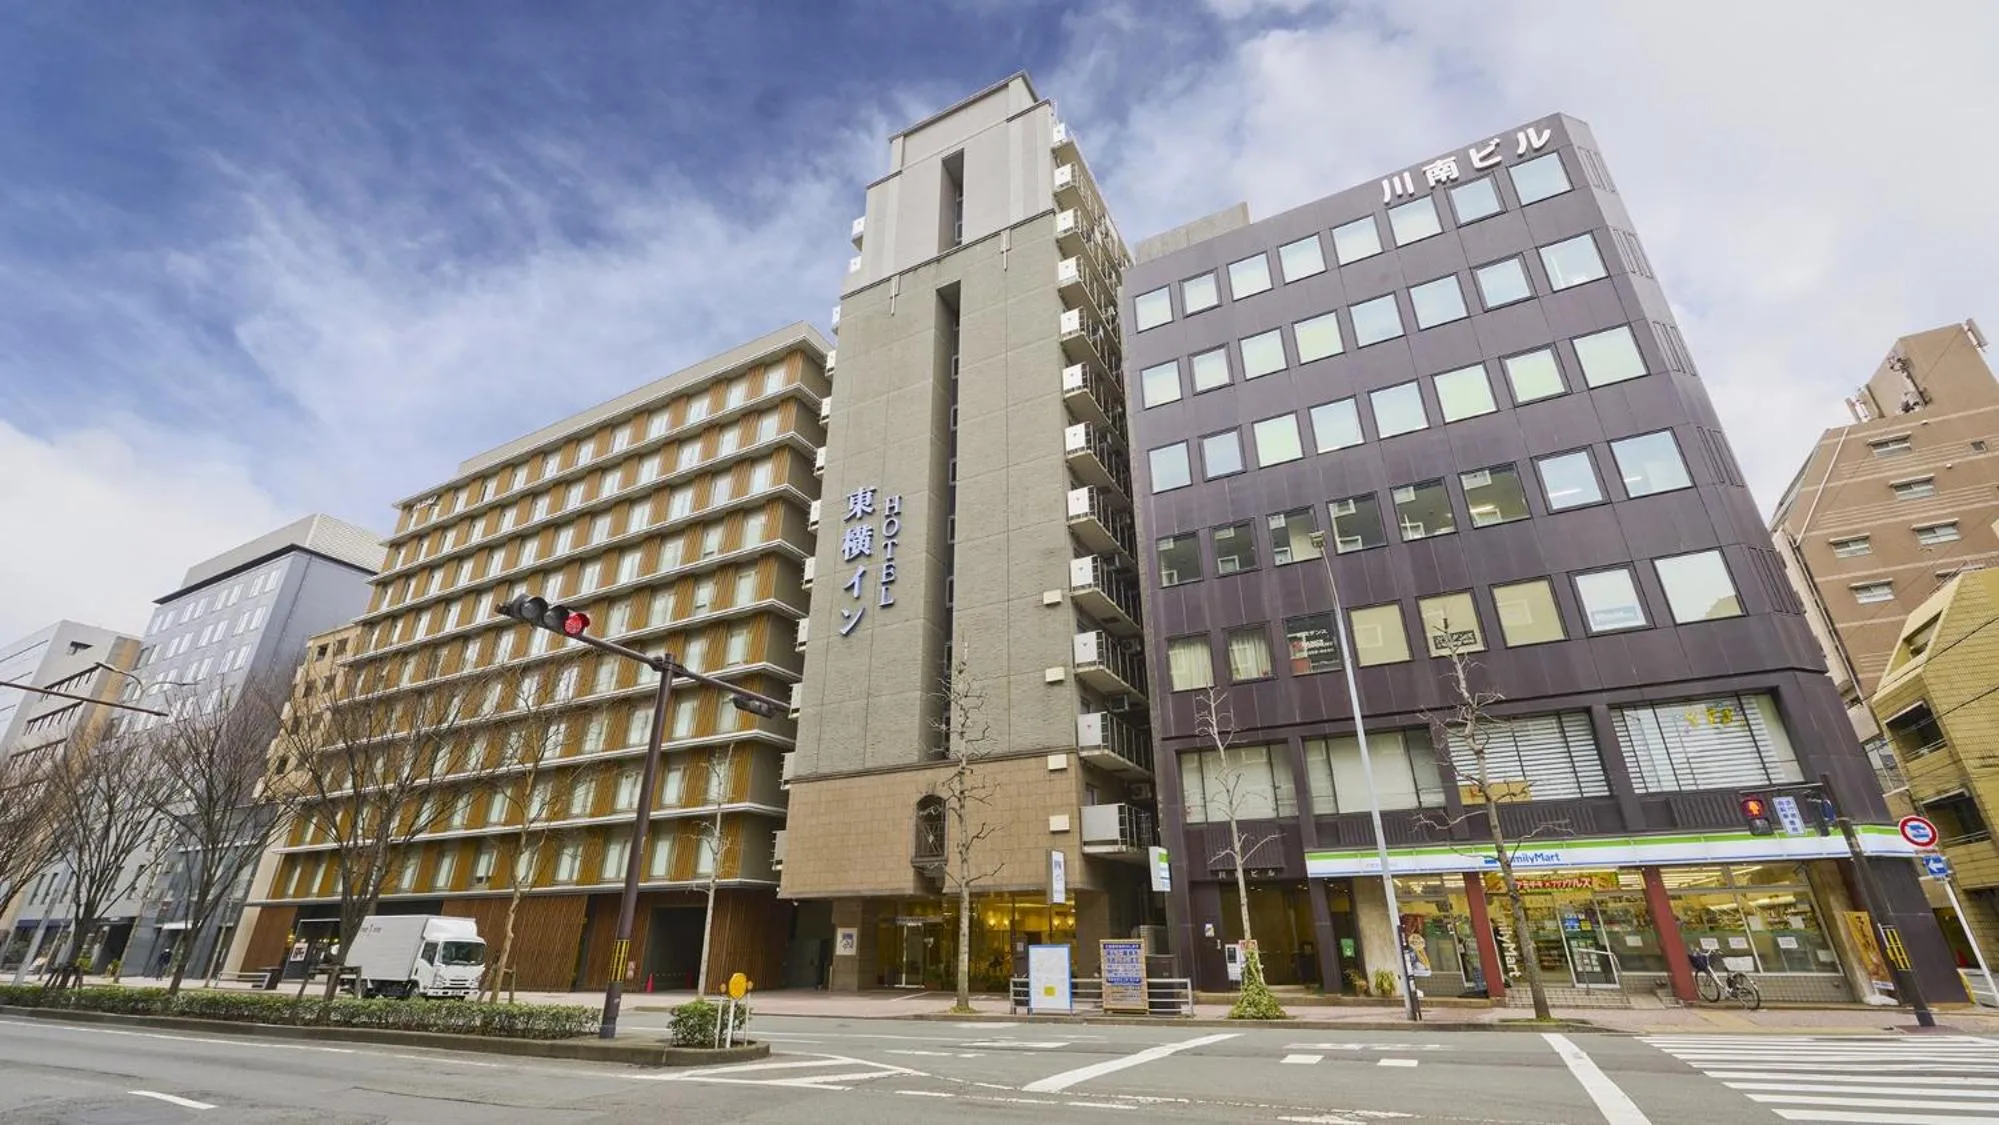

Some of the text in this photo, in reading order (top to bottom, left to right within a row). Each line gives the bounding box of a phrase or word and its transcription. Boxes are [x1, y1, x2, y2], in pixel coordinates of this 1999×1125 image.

[1381, 127, 1551, 204] 川南ビル
[840, 486, 877, 636] 東横イン
[879, 495, 902, 608] HOTEL
[1511, 852, 1561, 864] milyMart
